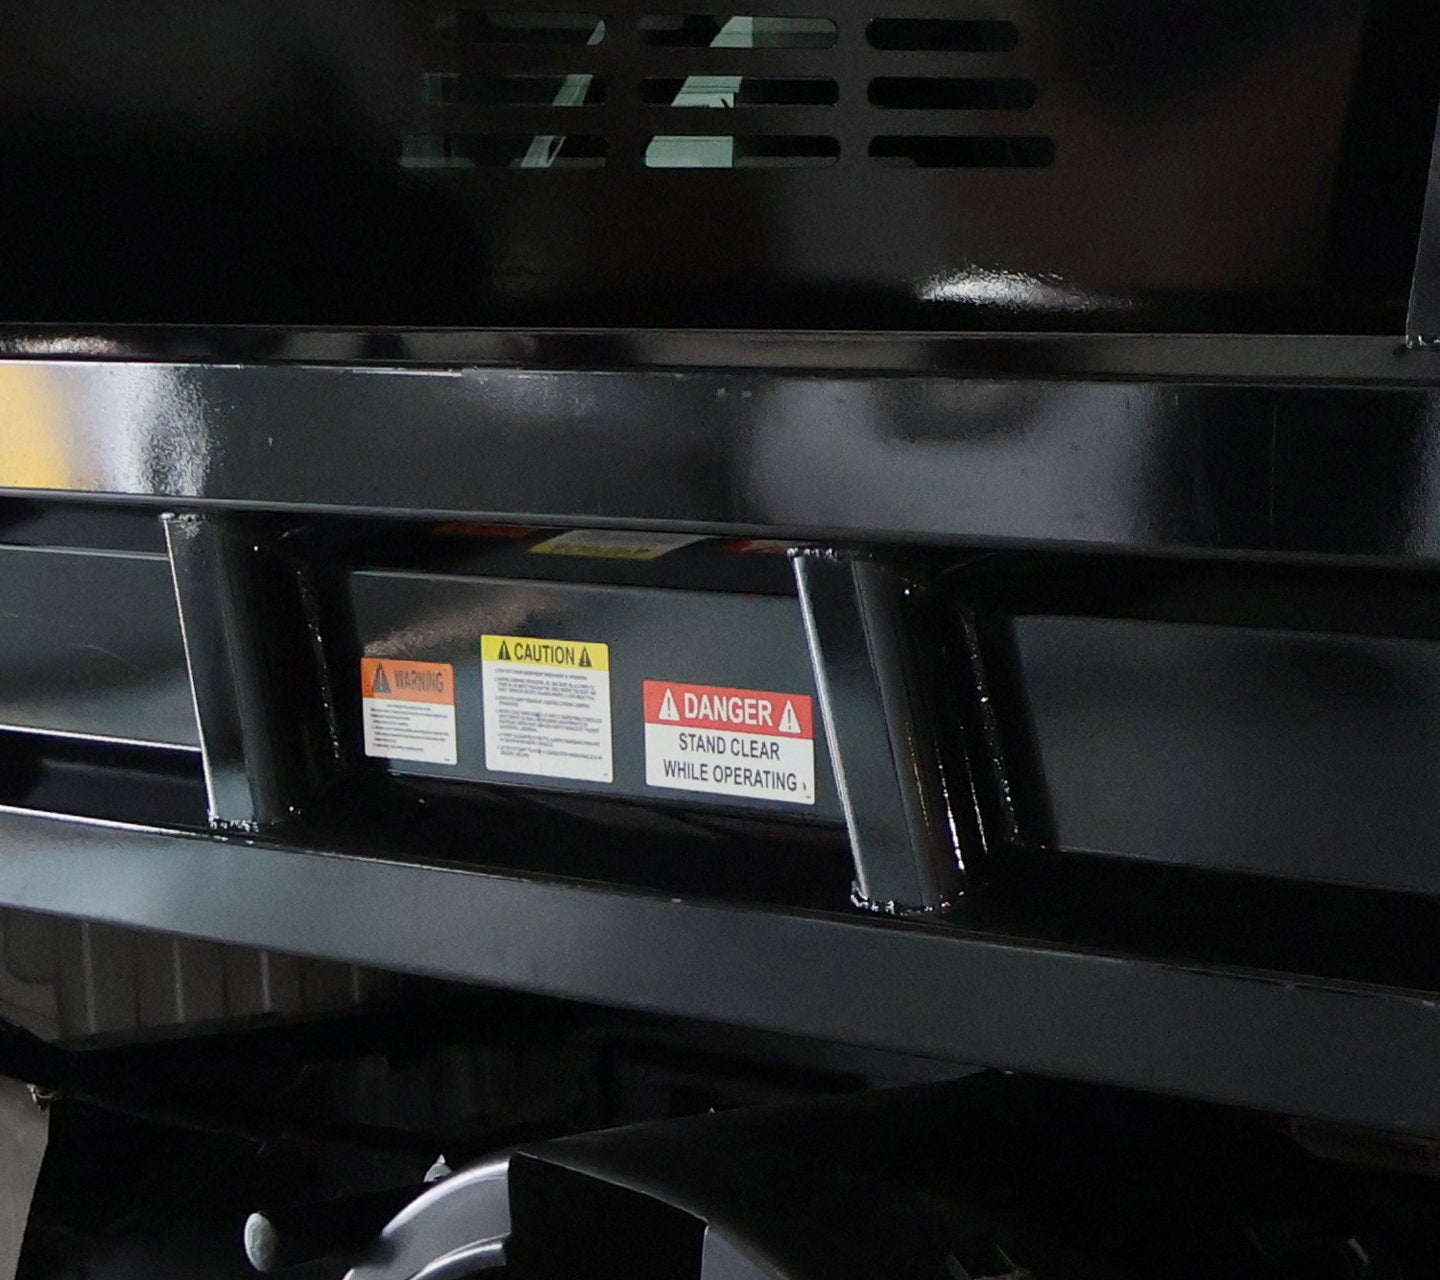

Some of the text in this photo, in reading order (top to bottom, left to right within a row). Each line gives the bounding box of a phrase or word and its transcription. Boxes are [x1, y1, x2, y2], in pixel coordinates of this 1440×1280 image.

[513, 642, 576, 665] CAUTION
[394, 669, 444, 694] WARNING
[683, 692, 774, 727] DANGER
[679, 732, 781, 761] STAND CLEAR
[663, 758, 798, 792] WHILE OPERATING
